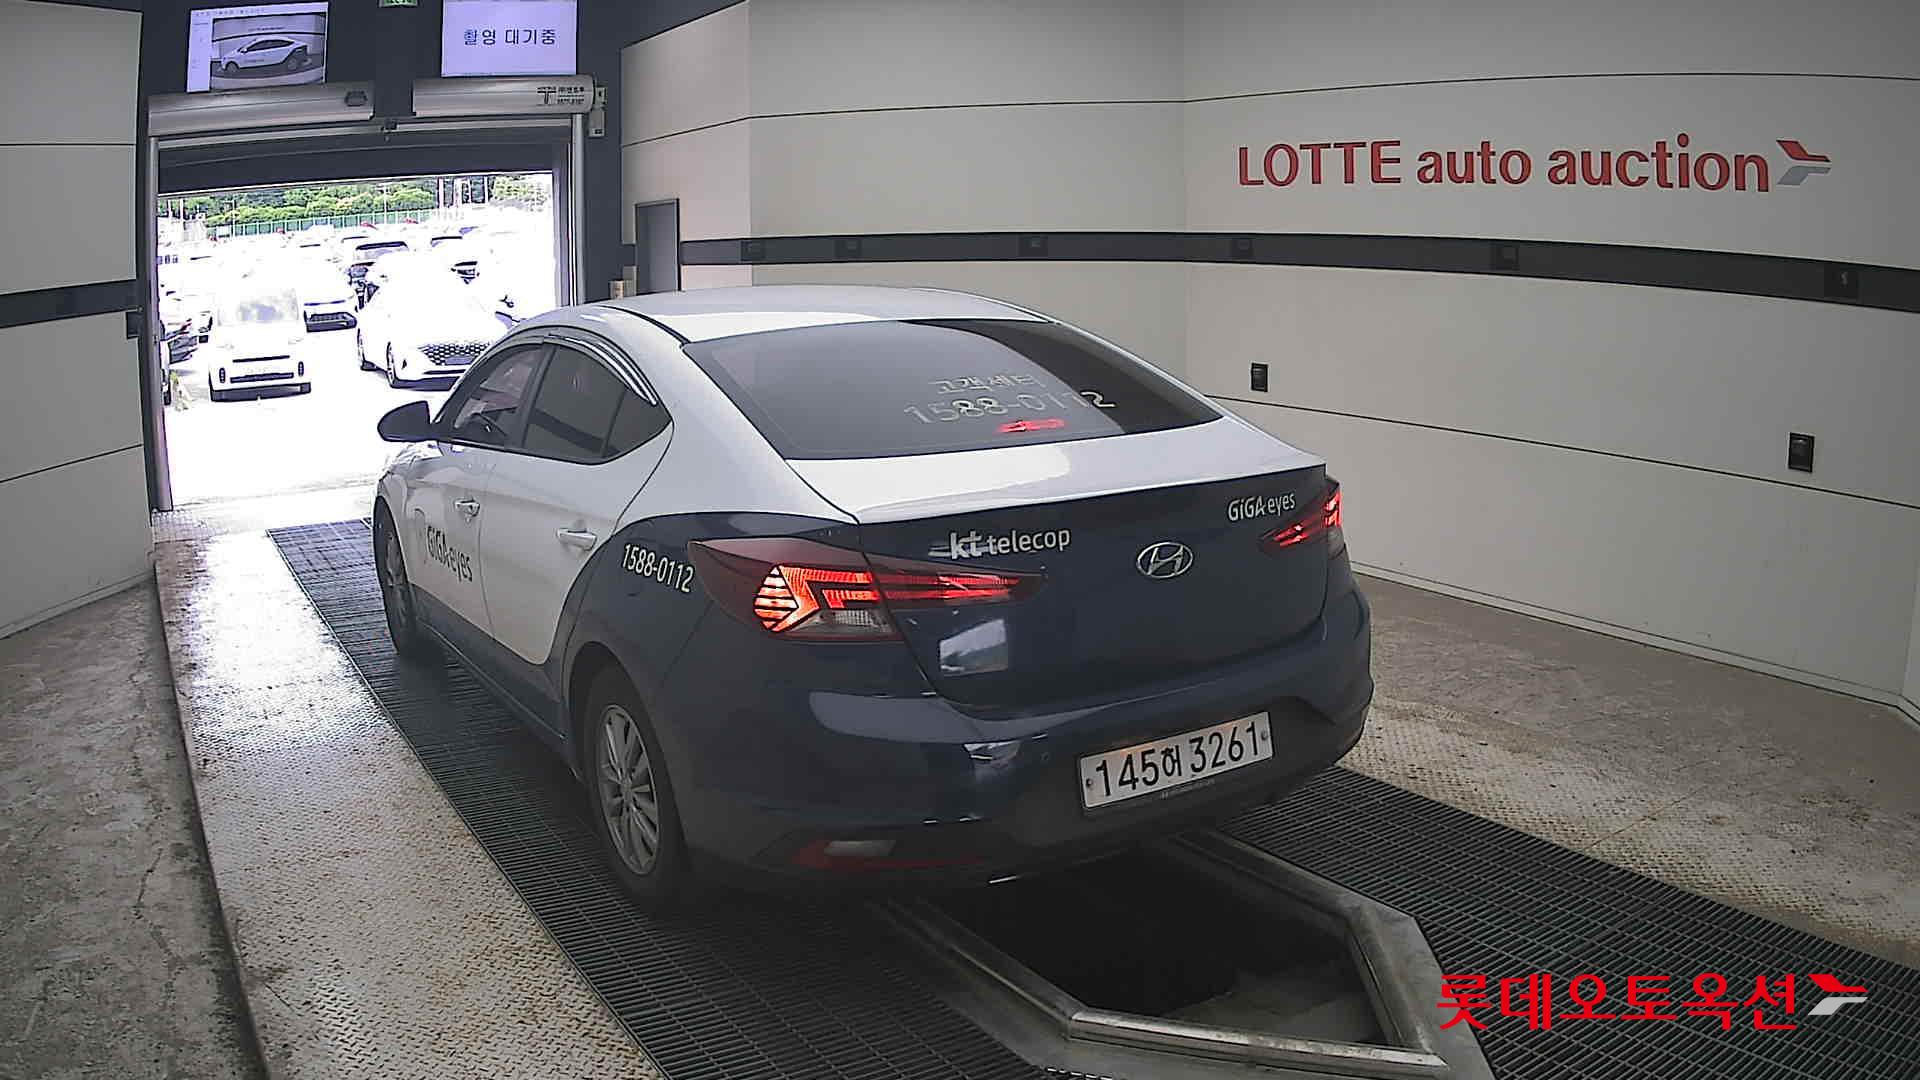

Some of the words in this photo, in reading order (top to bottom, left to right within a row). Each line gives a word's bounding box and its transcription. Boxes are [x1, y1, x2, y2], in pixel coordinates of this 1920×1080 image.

[504, 28, 556, 45] 대기중
[1239, 140, 1401, 187] LOTTE
[1416, 140, 1532, 186] auto
[1547, 133, 1770, 193] auction
[903, 390, 1116, 424] 1588-0112
[987, 529, 1071, 555] telecop
[621, 544, 695, 593] 1588-0112
[1096, 745, 1183, 797] 145허
[1189, 721, 1259, 774] 3261
